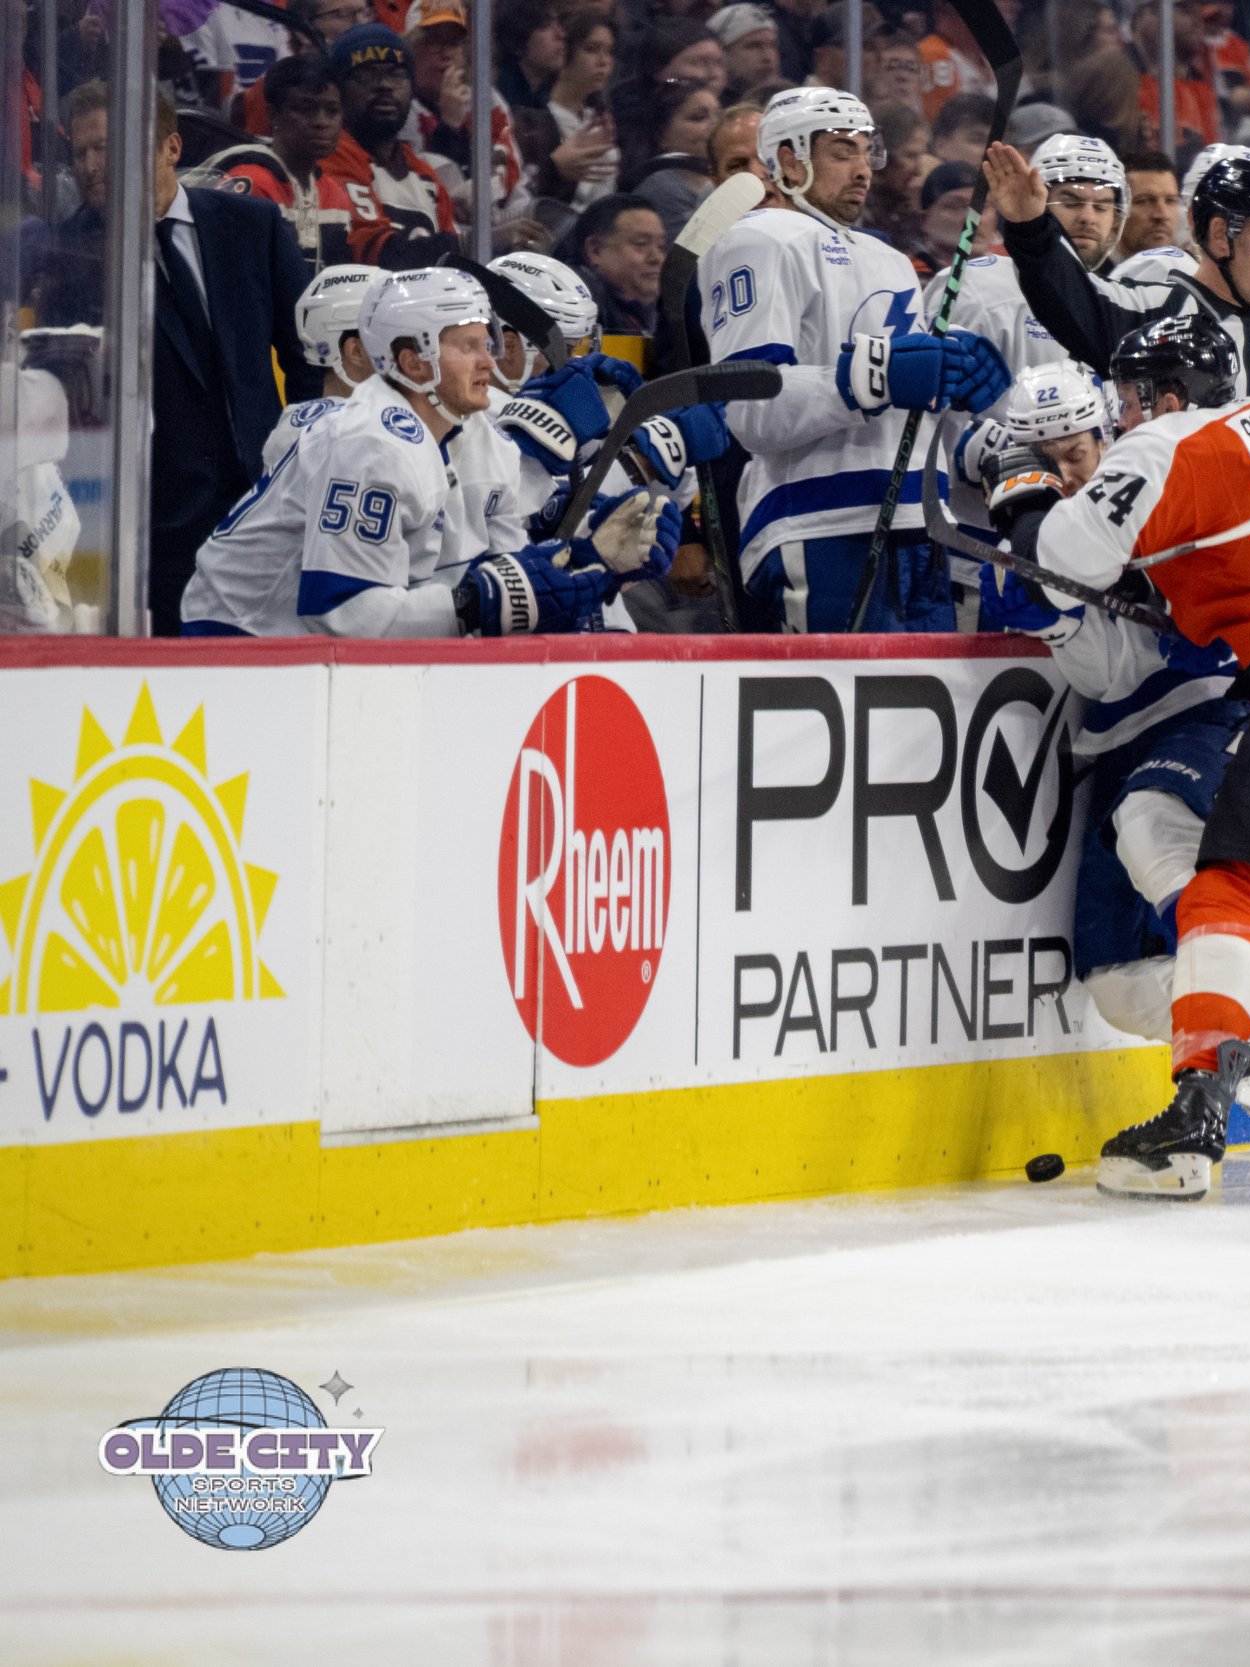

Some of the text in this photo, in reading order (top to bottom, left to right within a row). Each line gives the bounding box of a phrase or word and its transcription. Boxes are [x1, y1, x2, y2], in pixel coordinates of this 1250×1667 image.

[350, 46, 404, 67] NAVY
[1076, 155, 1109, 164] CCM
[346, 183, 378, 221] 5
[322, 274, 369, 289] BRANDT
[498, 260, 546, 277] BRANDT
[934, 207, 982, 334] CCM
[711, 265, 757, 337] 20
[1035, 411, 1070, 425] CCM
[1036, 387, 1060, 403] 22
[319, 478, 397, 546] 59
[734, 666, 1075, 913] PRO
[514, 680, 665, 1010] Rheem
[732, 934, 1073, 1060] PARTNER
[31, 1015, 227, 1122] VODKA
